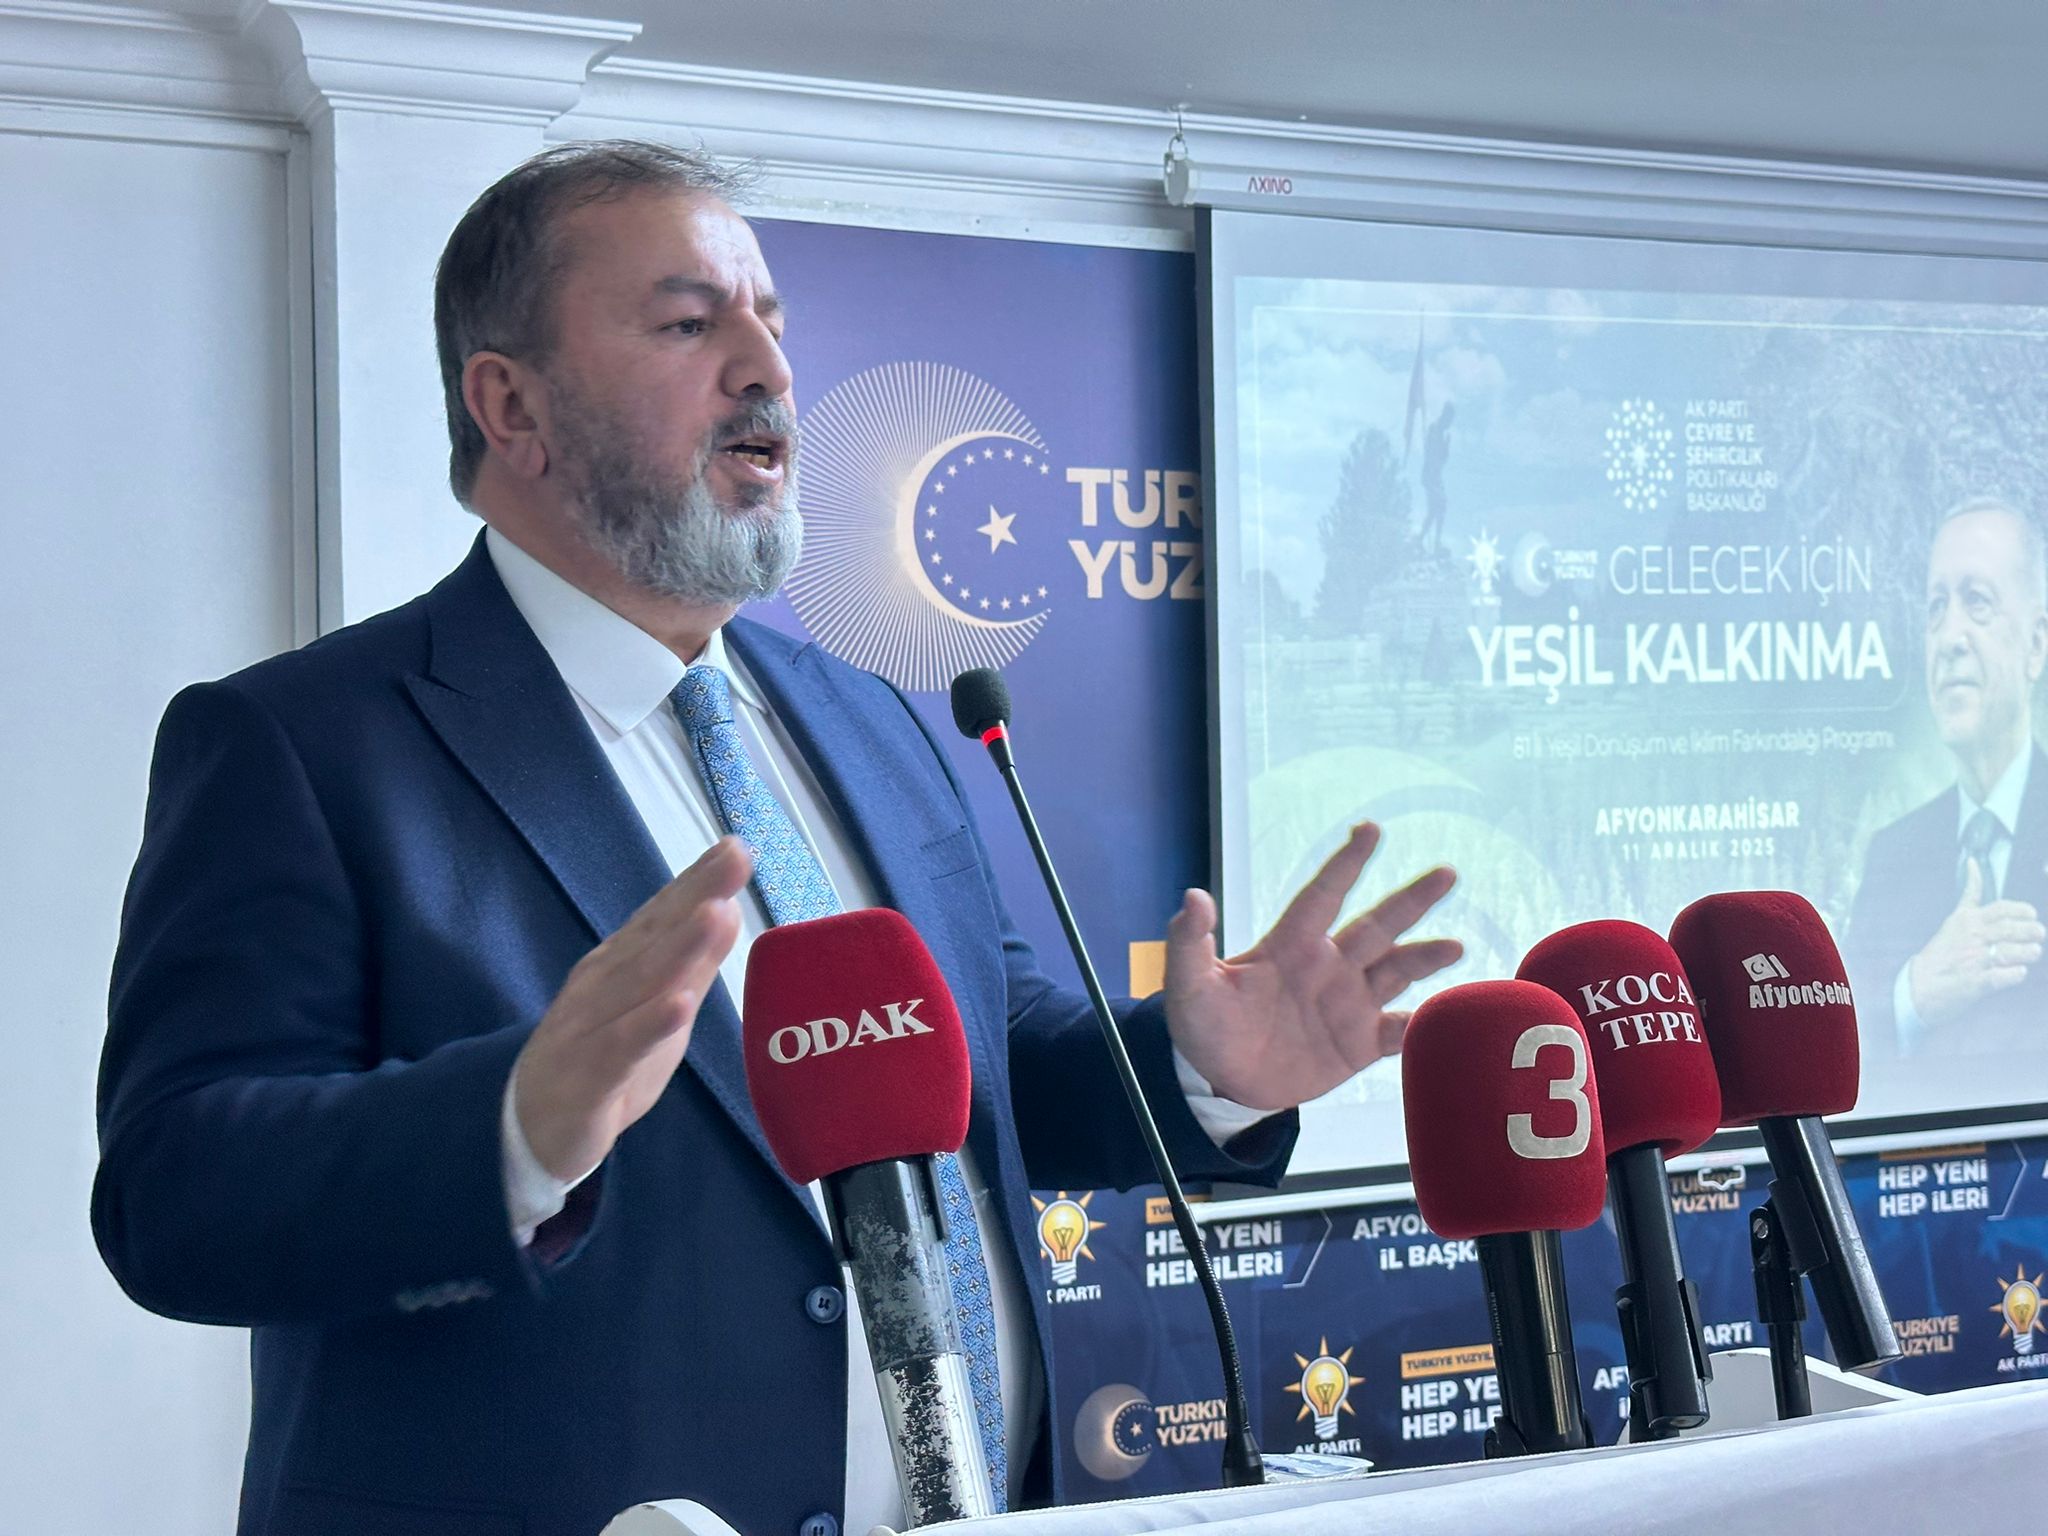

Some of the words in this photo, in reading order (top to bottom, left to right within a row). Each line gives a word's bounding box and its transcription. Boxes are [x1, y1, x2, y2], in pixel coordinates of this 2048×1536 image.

[1609, 545, 1791, 594] GELECEK
[1800, 534, 1872, 607] İÇİN
[1467, 605, 1614, 704] YEŞİL
[1625, 621, 1893, 684] KALKINMA
[1594, 796, 1799, 836] AFYONKARAHİSAR
[1622, 843, 1640, 862] 11
[1649, 841, 1720, 861] ARALIK
[1730, 837, 1775, 858] 2025
[1577, 972, 1695, 1017] KOCA
[768, 998, 934, 1064] ODAK
[1600, 1010, 1702, 1051] TEPE
[1506, 1024, 1592, 1159] 3
[1879, 1165, 1928, 1190] HEP
[1879, 1192, 1928, 1218] HEP
[1146, 1229, 1207, 1257] HE
[1407, 1238, 1479, 1271] BAŞK
[1997, 1357, 2016, 1373] AK
[1401, 1380, 1459, 1410] HEP
[1402, 1410, 1458, 1440] HEP
